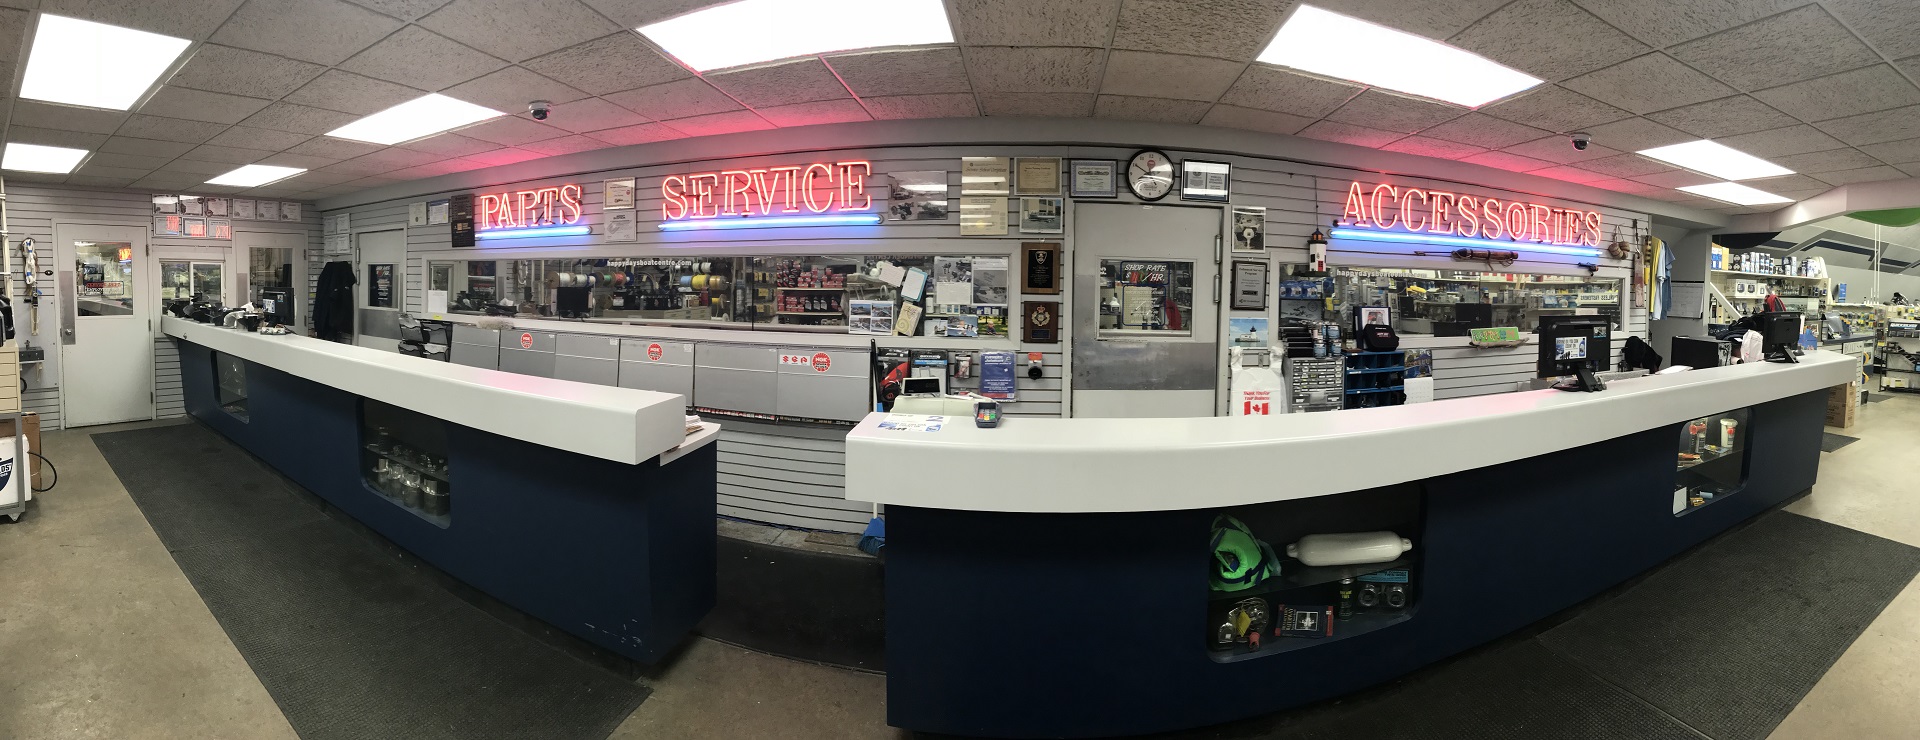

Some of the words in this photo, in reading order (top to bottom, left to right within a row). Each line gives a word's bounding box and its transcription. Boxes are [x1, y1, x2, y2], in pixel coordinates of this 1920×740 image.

[480, 184, 582, 230] PARTS
[662, 161, 871, 220] SERVICE
[1337, 181, 1601, 247] ACCESSORIES
